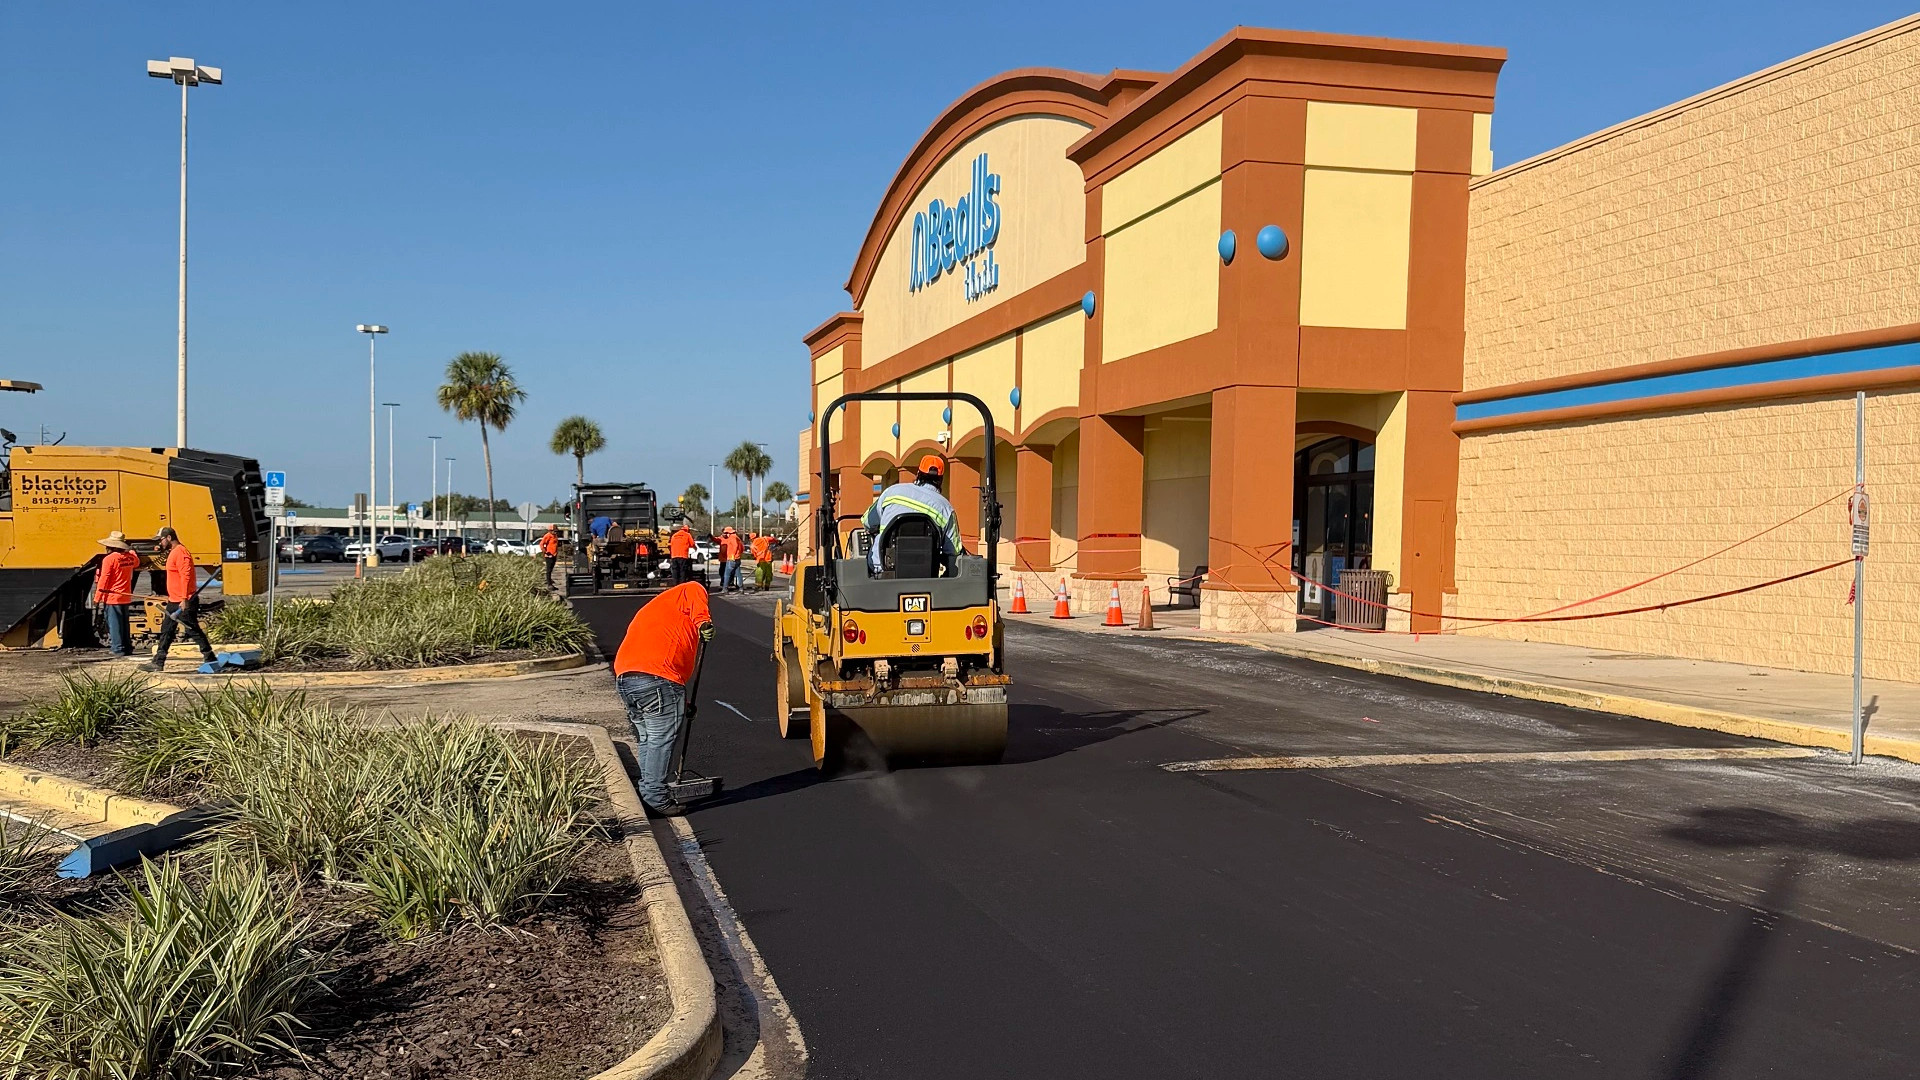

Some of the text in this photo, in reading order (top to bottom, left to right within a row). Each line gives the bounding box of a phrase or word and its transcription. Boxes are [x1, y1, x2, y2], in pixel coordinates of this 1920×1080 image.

[928, 153, 1000, 283] Bealls
[22, 475, 107, 494] blacktop
[905, 598, 925, 611] CAT
